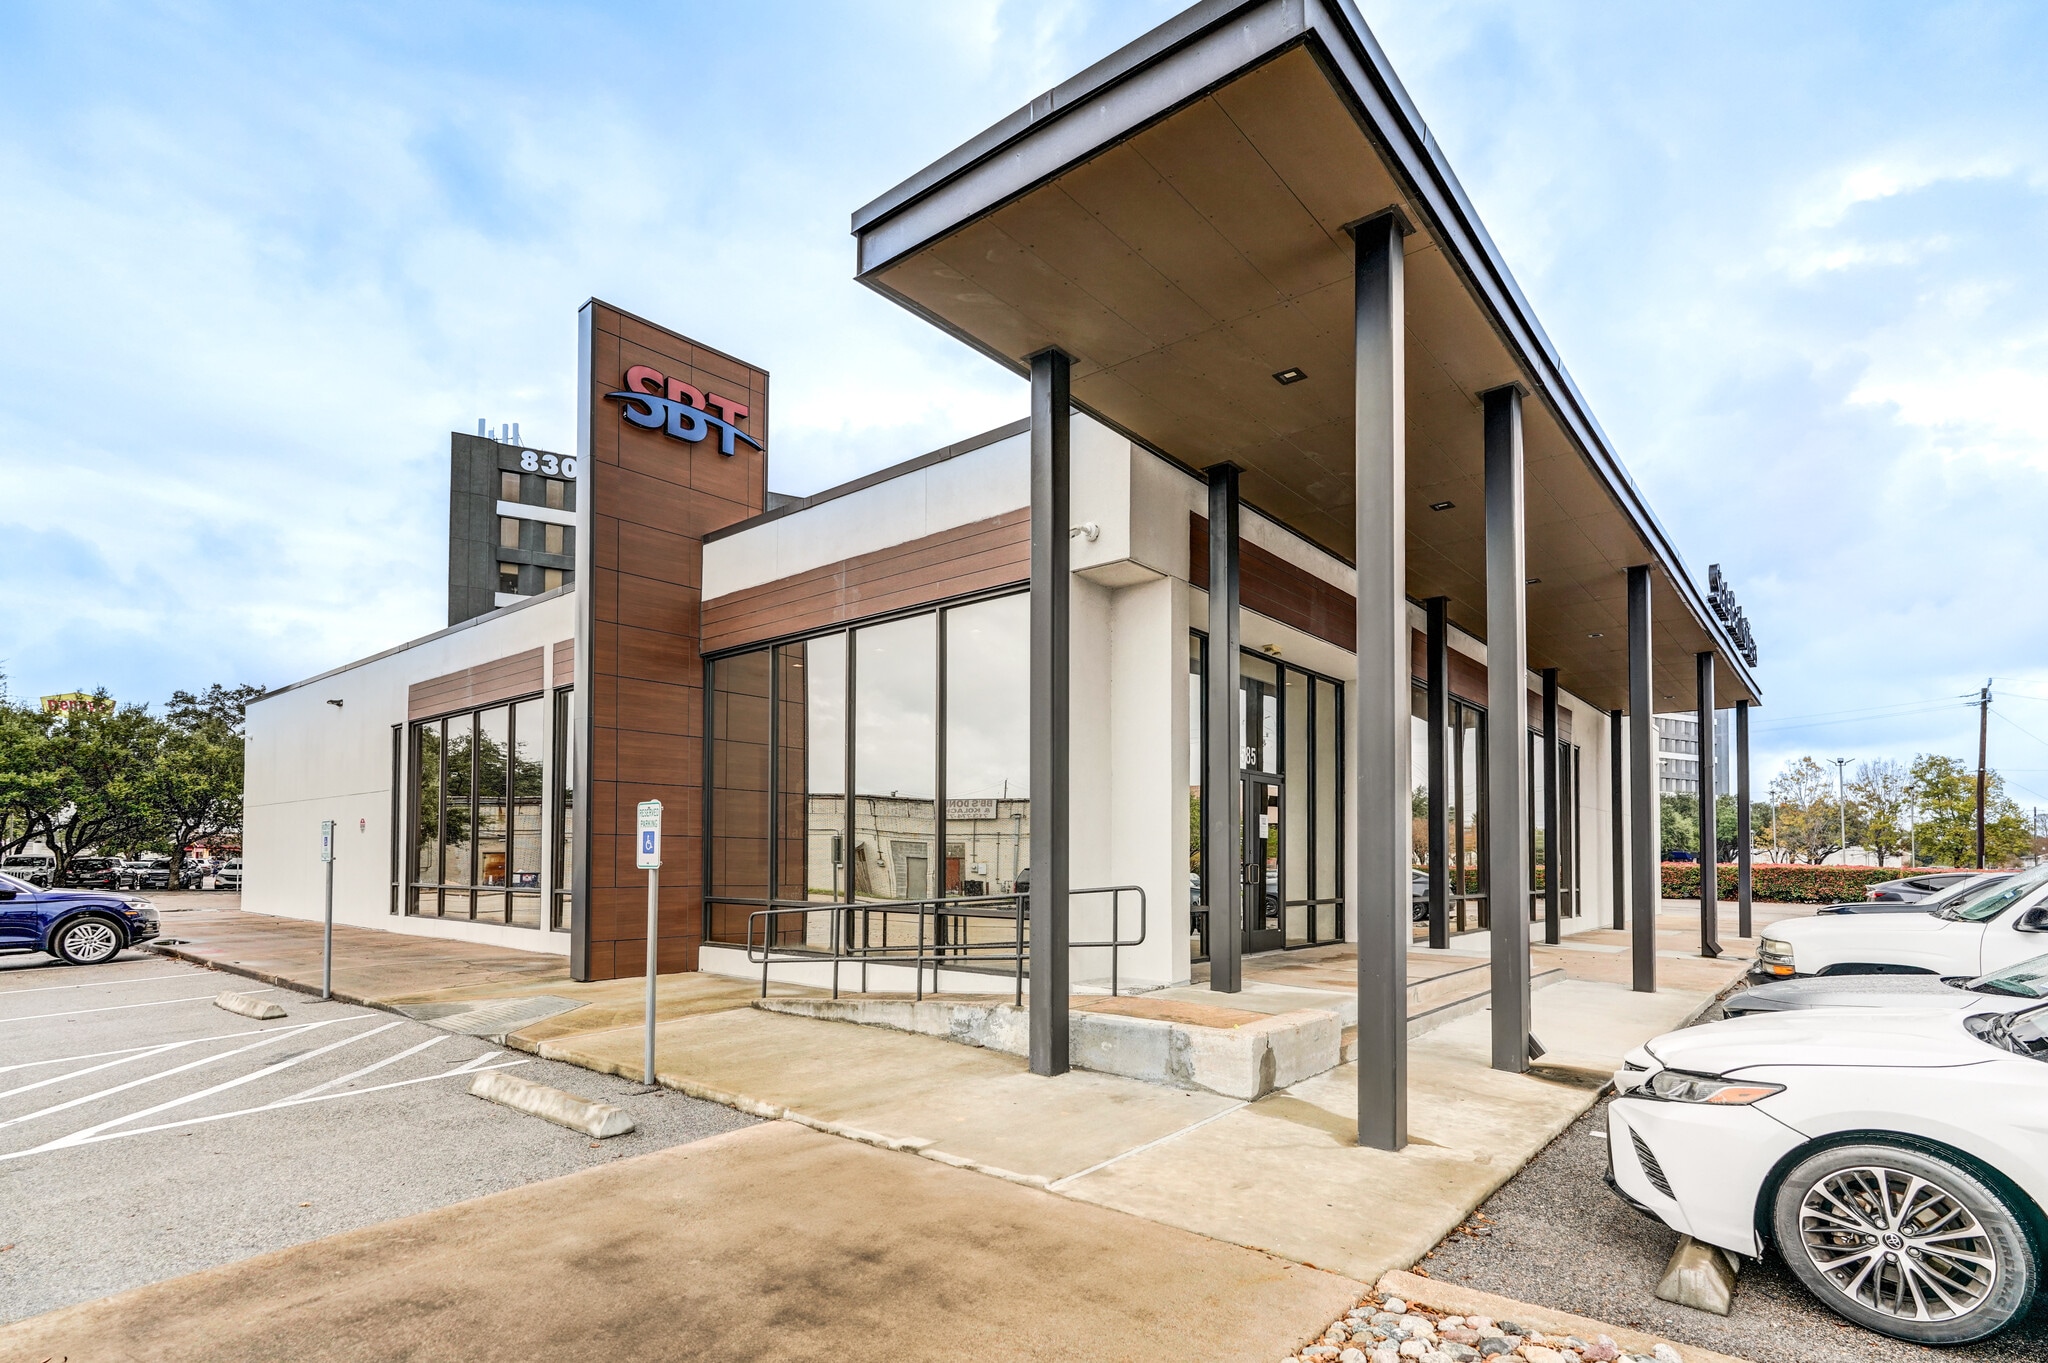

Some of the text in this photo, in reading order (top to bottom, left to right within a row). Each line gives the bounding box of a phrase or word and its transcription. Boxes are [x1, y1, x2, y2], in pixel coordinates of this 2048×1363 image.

[624, 365, 748, 457] SBT
[639, 808, 659, 817] RESERVED
[640, 819, 658, 827] PARKING
